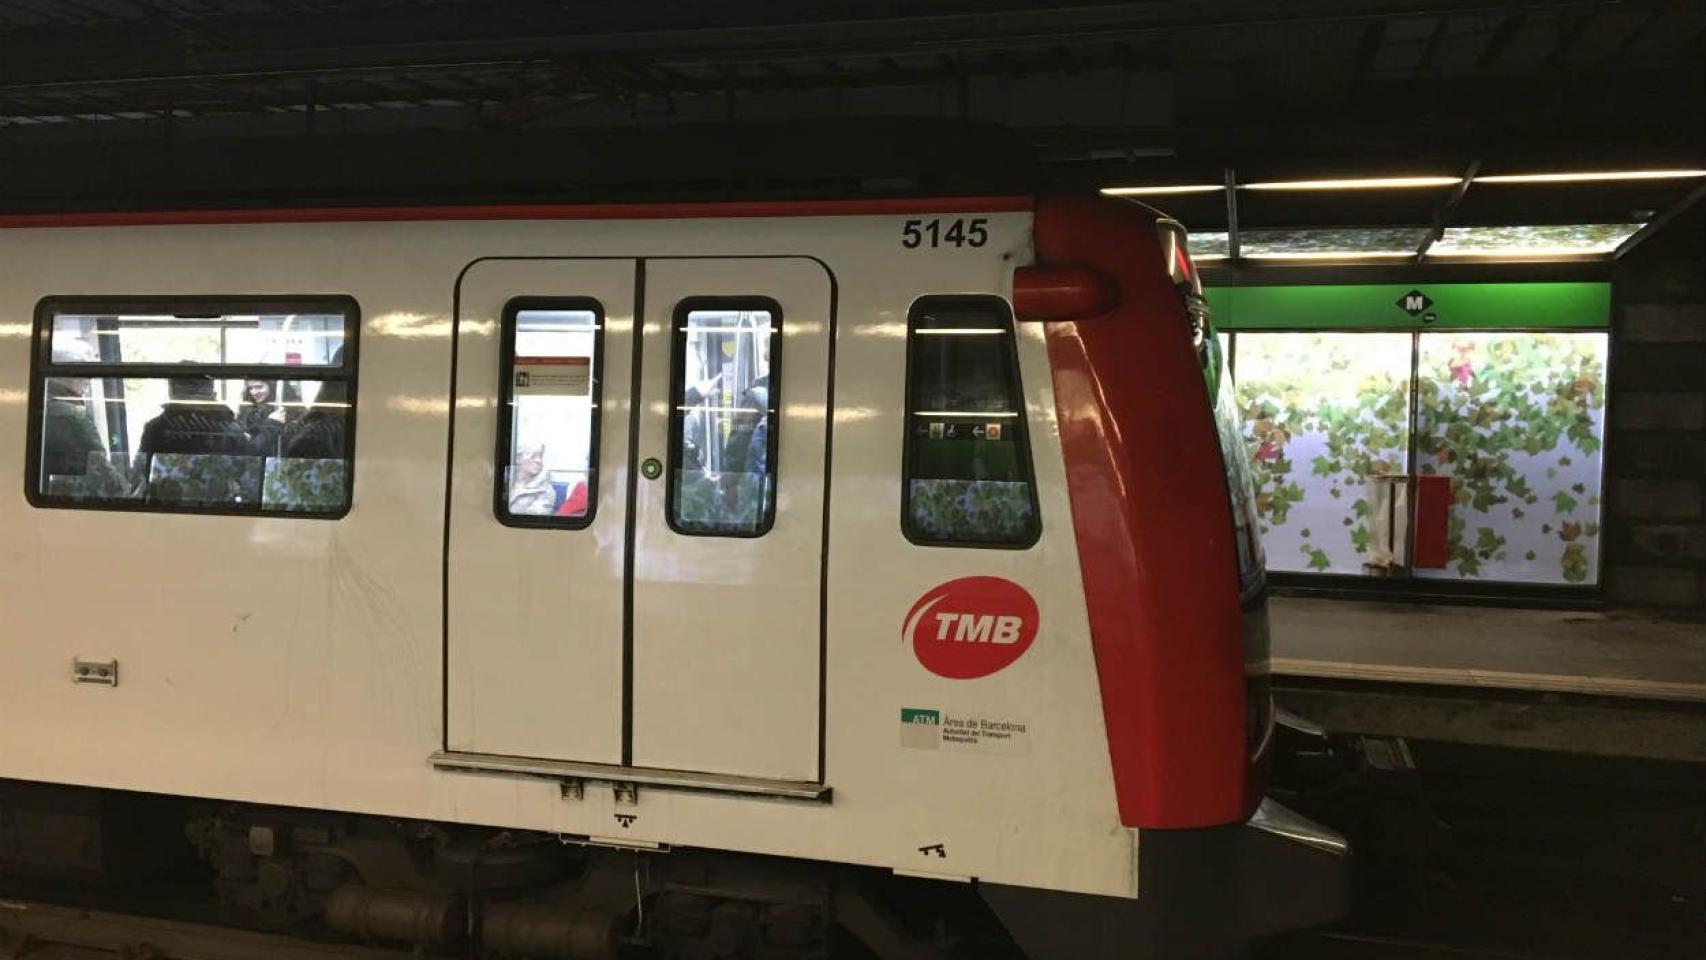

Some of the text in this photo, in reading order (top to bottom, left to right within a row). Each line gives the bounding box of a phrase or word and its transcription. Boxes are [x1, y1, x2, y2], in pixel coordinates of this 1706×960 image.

[902, 218, 988, 249] 5145
[1406, 295, 1423, 310] M
[935, 612, 1023, 644] TMB
[912, 715, 937, 726] ATM
[966, 719, 978, 729] de
[980, 719, 1026, 733] Barcelona
